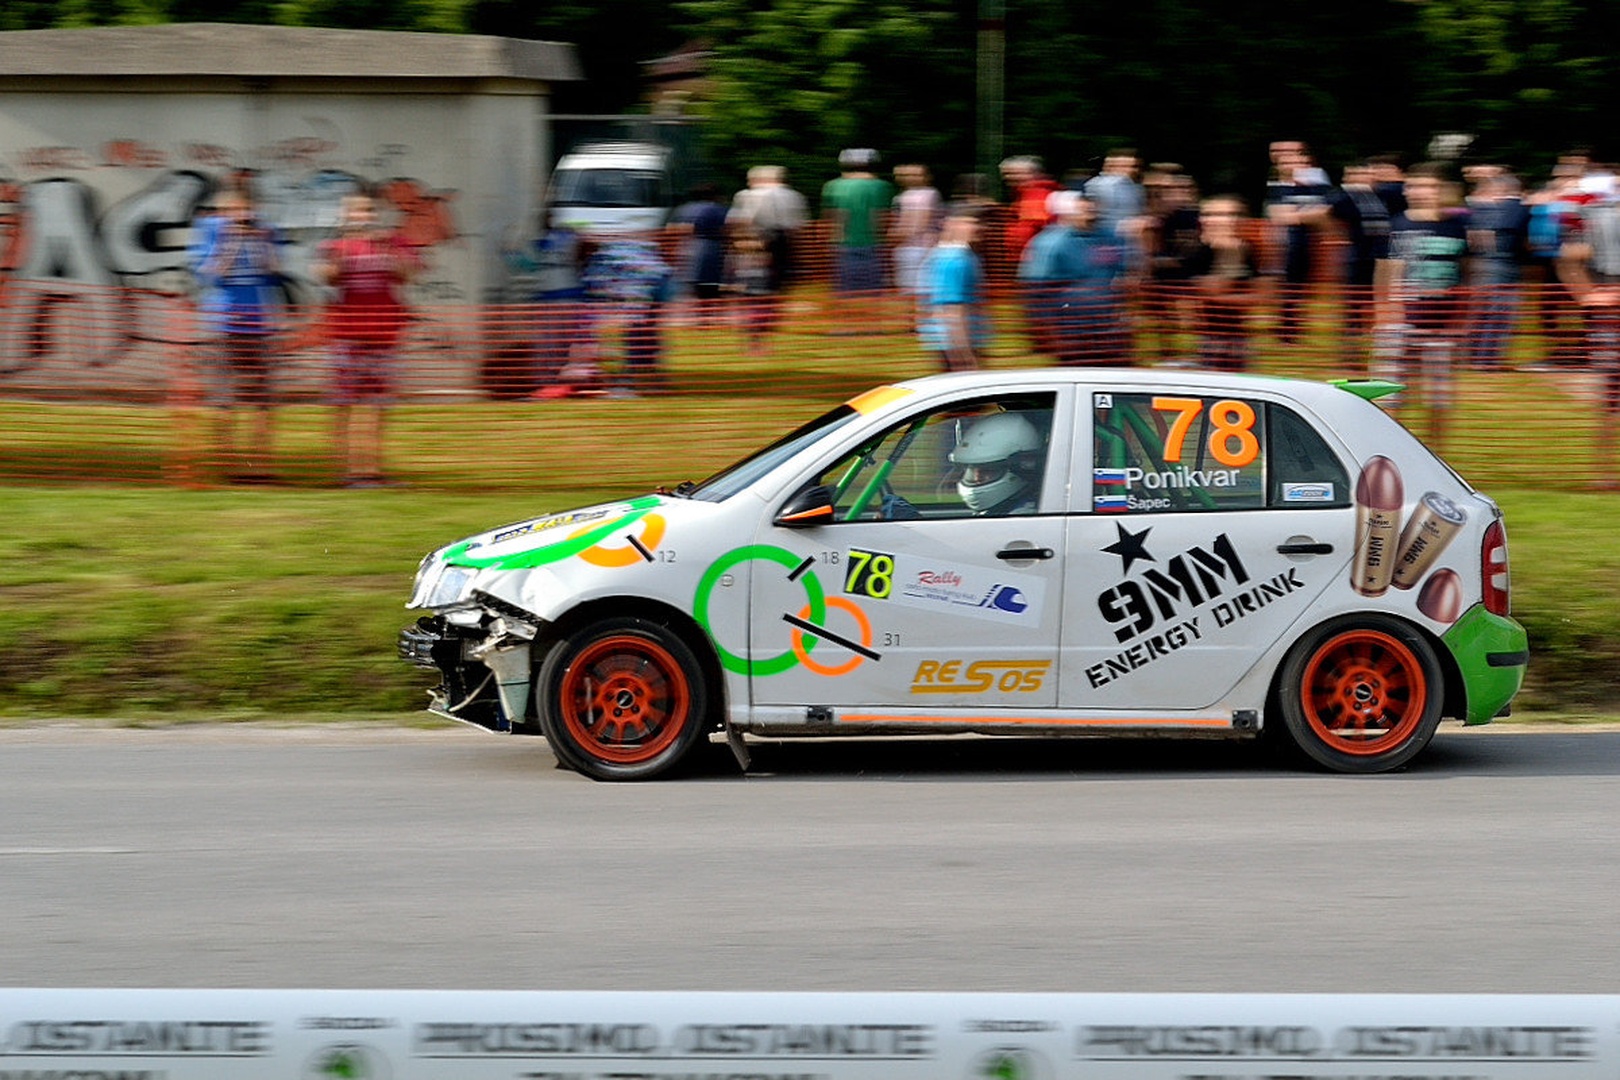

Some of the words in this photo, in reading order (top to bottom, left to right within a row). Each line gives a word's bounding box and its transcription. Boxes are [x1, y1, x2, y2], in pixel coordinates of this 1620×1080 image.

[1151, 396, 1260, 467] 78
[1125, 467, 1240, 490] Ponikvar
[1127, 496, 1171, 510] Šapec
[659, 550, 676, 563] 12
[821, 551, 840, 565] 18
[847, 550, 895, 598] 78
[918, 571, 962, 587] Rally
[1098, 533, 1250, 644] 9MM
[1084, 617, 1202, 690] ENERGY
[1211, 567, 1306, 628] DRINK
[884, 633, 900, 647] 31
